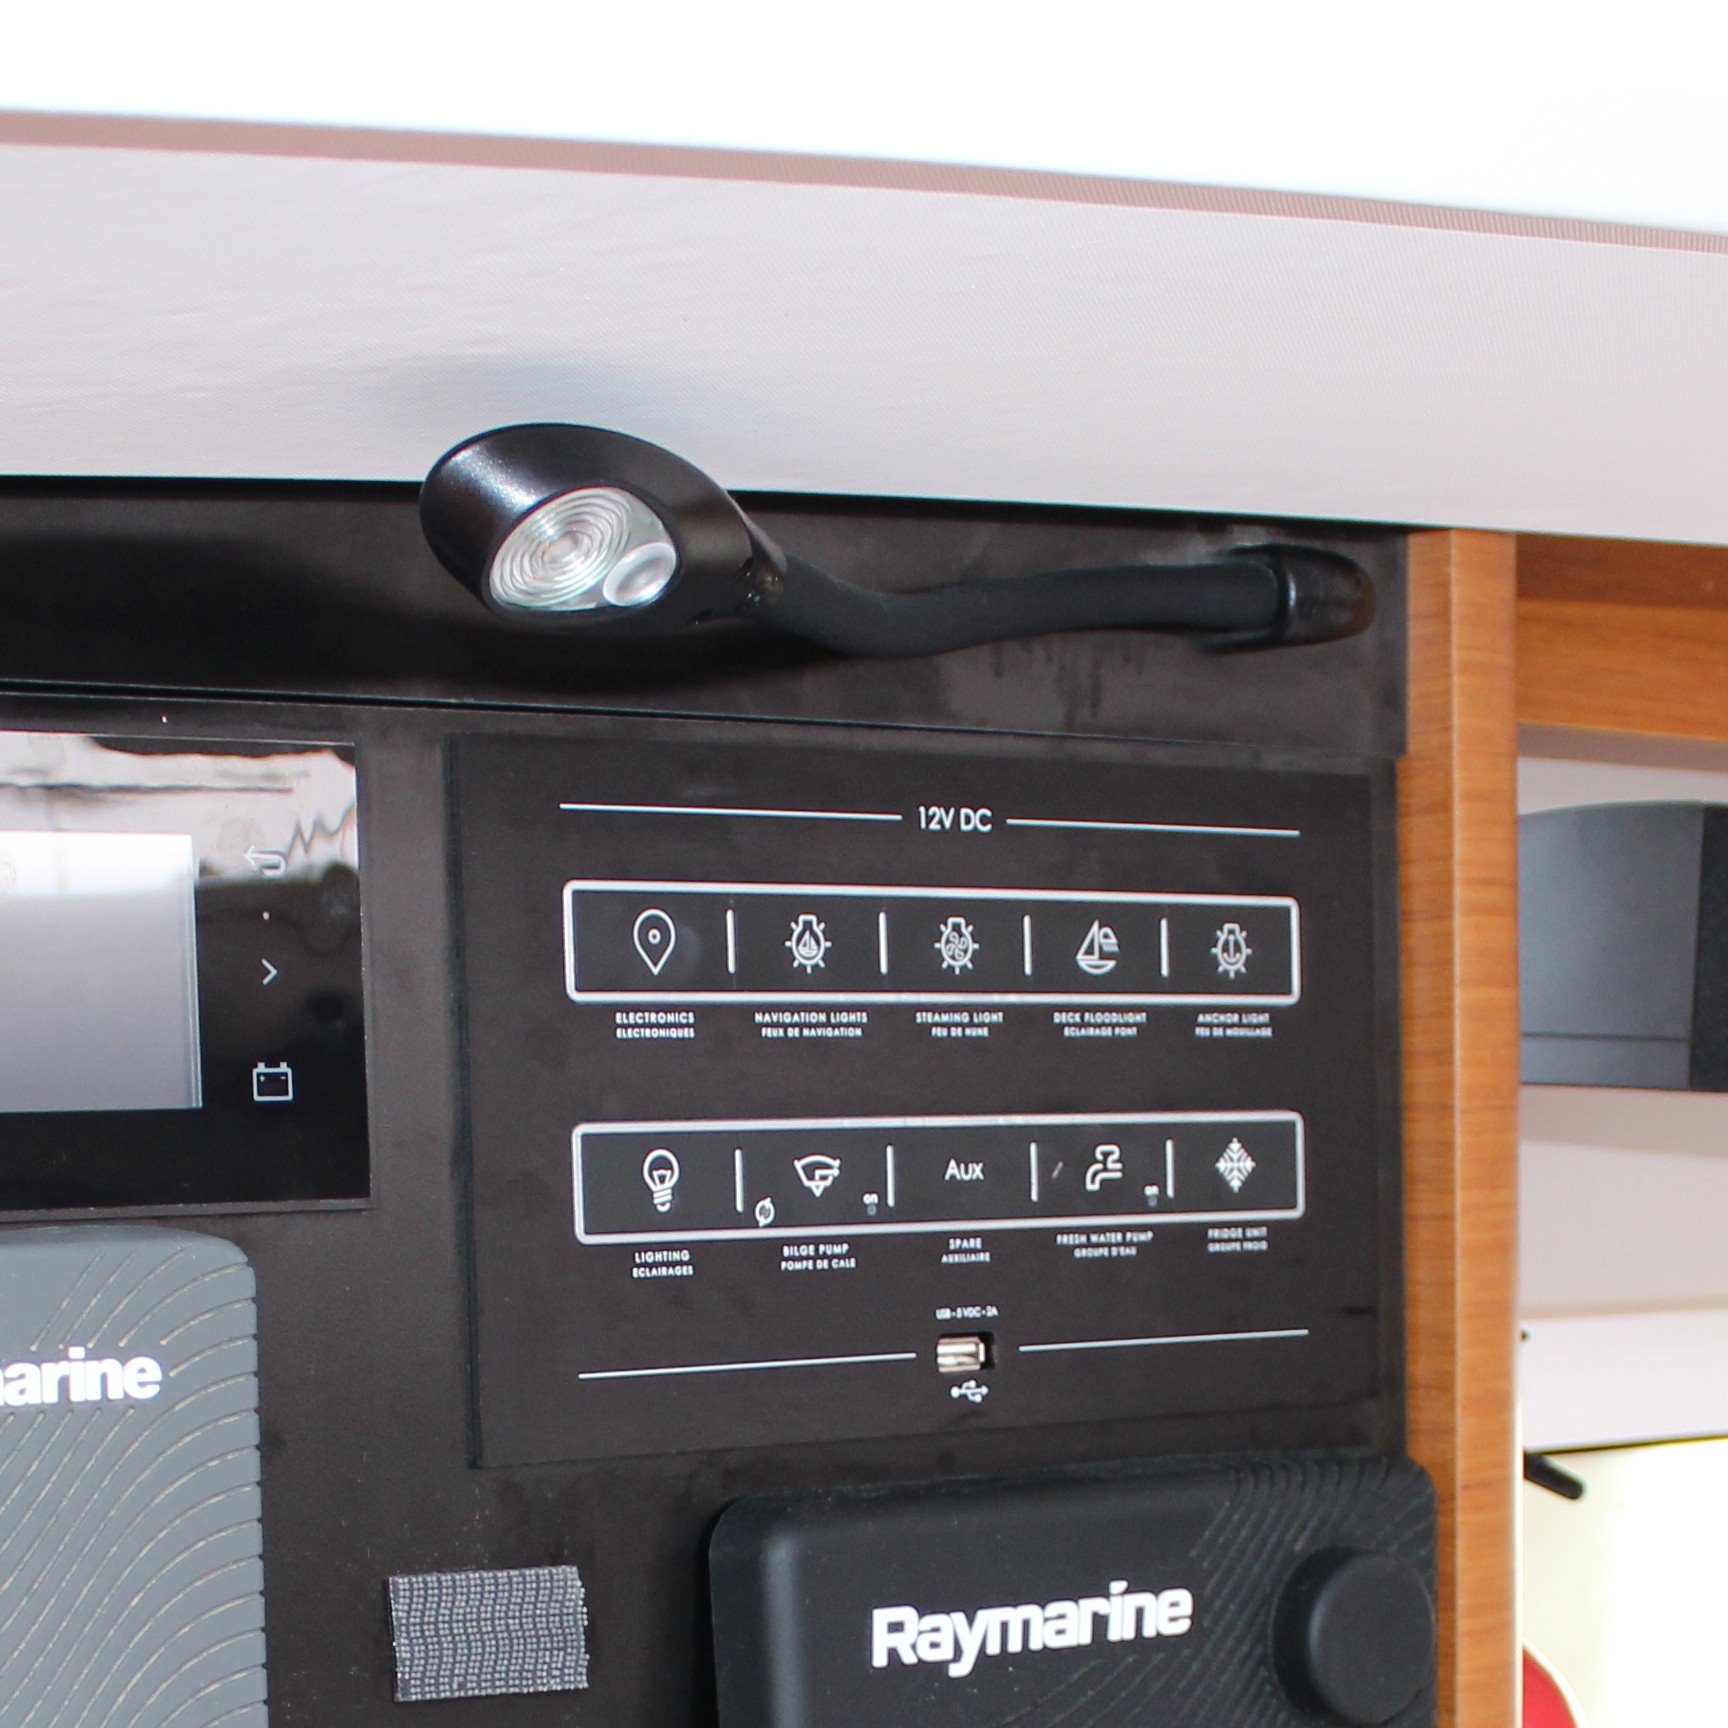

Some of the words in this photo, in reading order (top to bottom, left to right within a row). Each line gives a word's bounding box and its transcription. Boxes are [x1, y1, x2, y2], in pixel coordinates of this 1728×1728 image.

[918, 805, 955, 831] 12V
[959, 807, 992, 833] DC
[615, 1011, 695, 1025] ELECTRONICS
[754, 1011, 827, 1024] NAVIGATION
[830, 1011, 868, 1024] LIGHTS
[915, 1011, 971, 1024] STEAMING
[972, 1011, 1004, 1024] LIGHT
[1053, 1011, 1082, 1024] DECK
[761, 1027, 785, 1038] FEUX
[786, 1026, 800, 1038] DE
[802, 1026, 863, 1038] NAVIGATION
[950, 1026, 963, 1038] DE
[944, 1158, 984, 1181] Aux
[949, 1237, 982, 1250] SPARE
[1056, 1233, 1088, 1246] FRESH
[1089, 1231, 1123, 1244] WATER
[1125, 1230, 1154, 1243] PUMP
[634, 1249, 690, 1264] LIGHTING
[782, 1244, 816, 1258] BILGE
[818, 1242, 849, 1256] PUMP
[632, 1264, 694, 1278] ECLAIRAGES
[780, 1259, 814, 1271] POMPE
[815, 1258, 829, 1270] DE
[831, 1257, 856, 1269] CALE
[873, 1581, 1192, 1677] Raymarine
